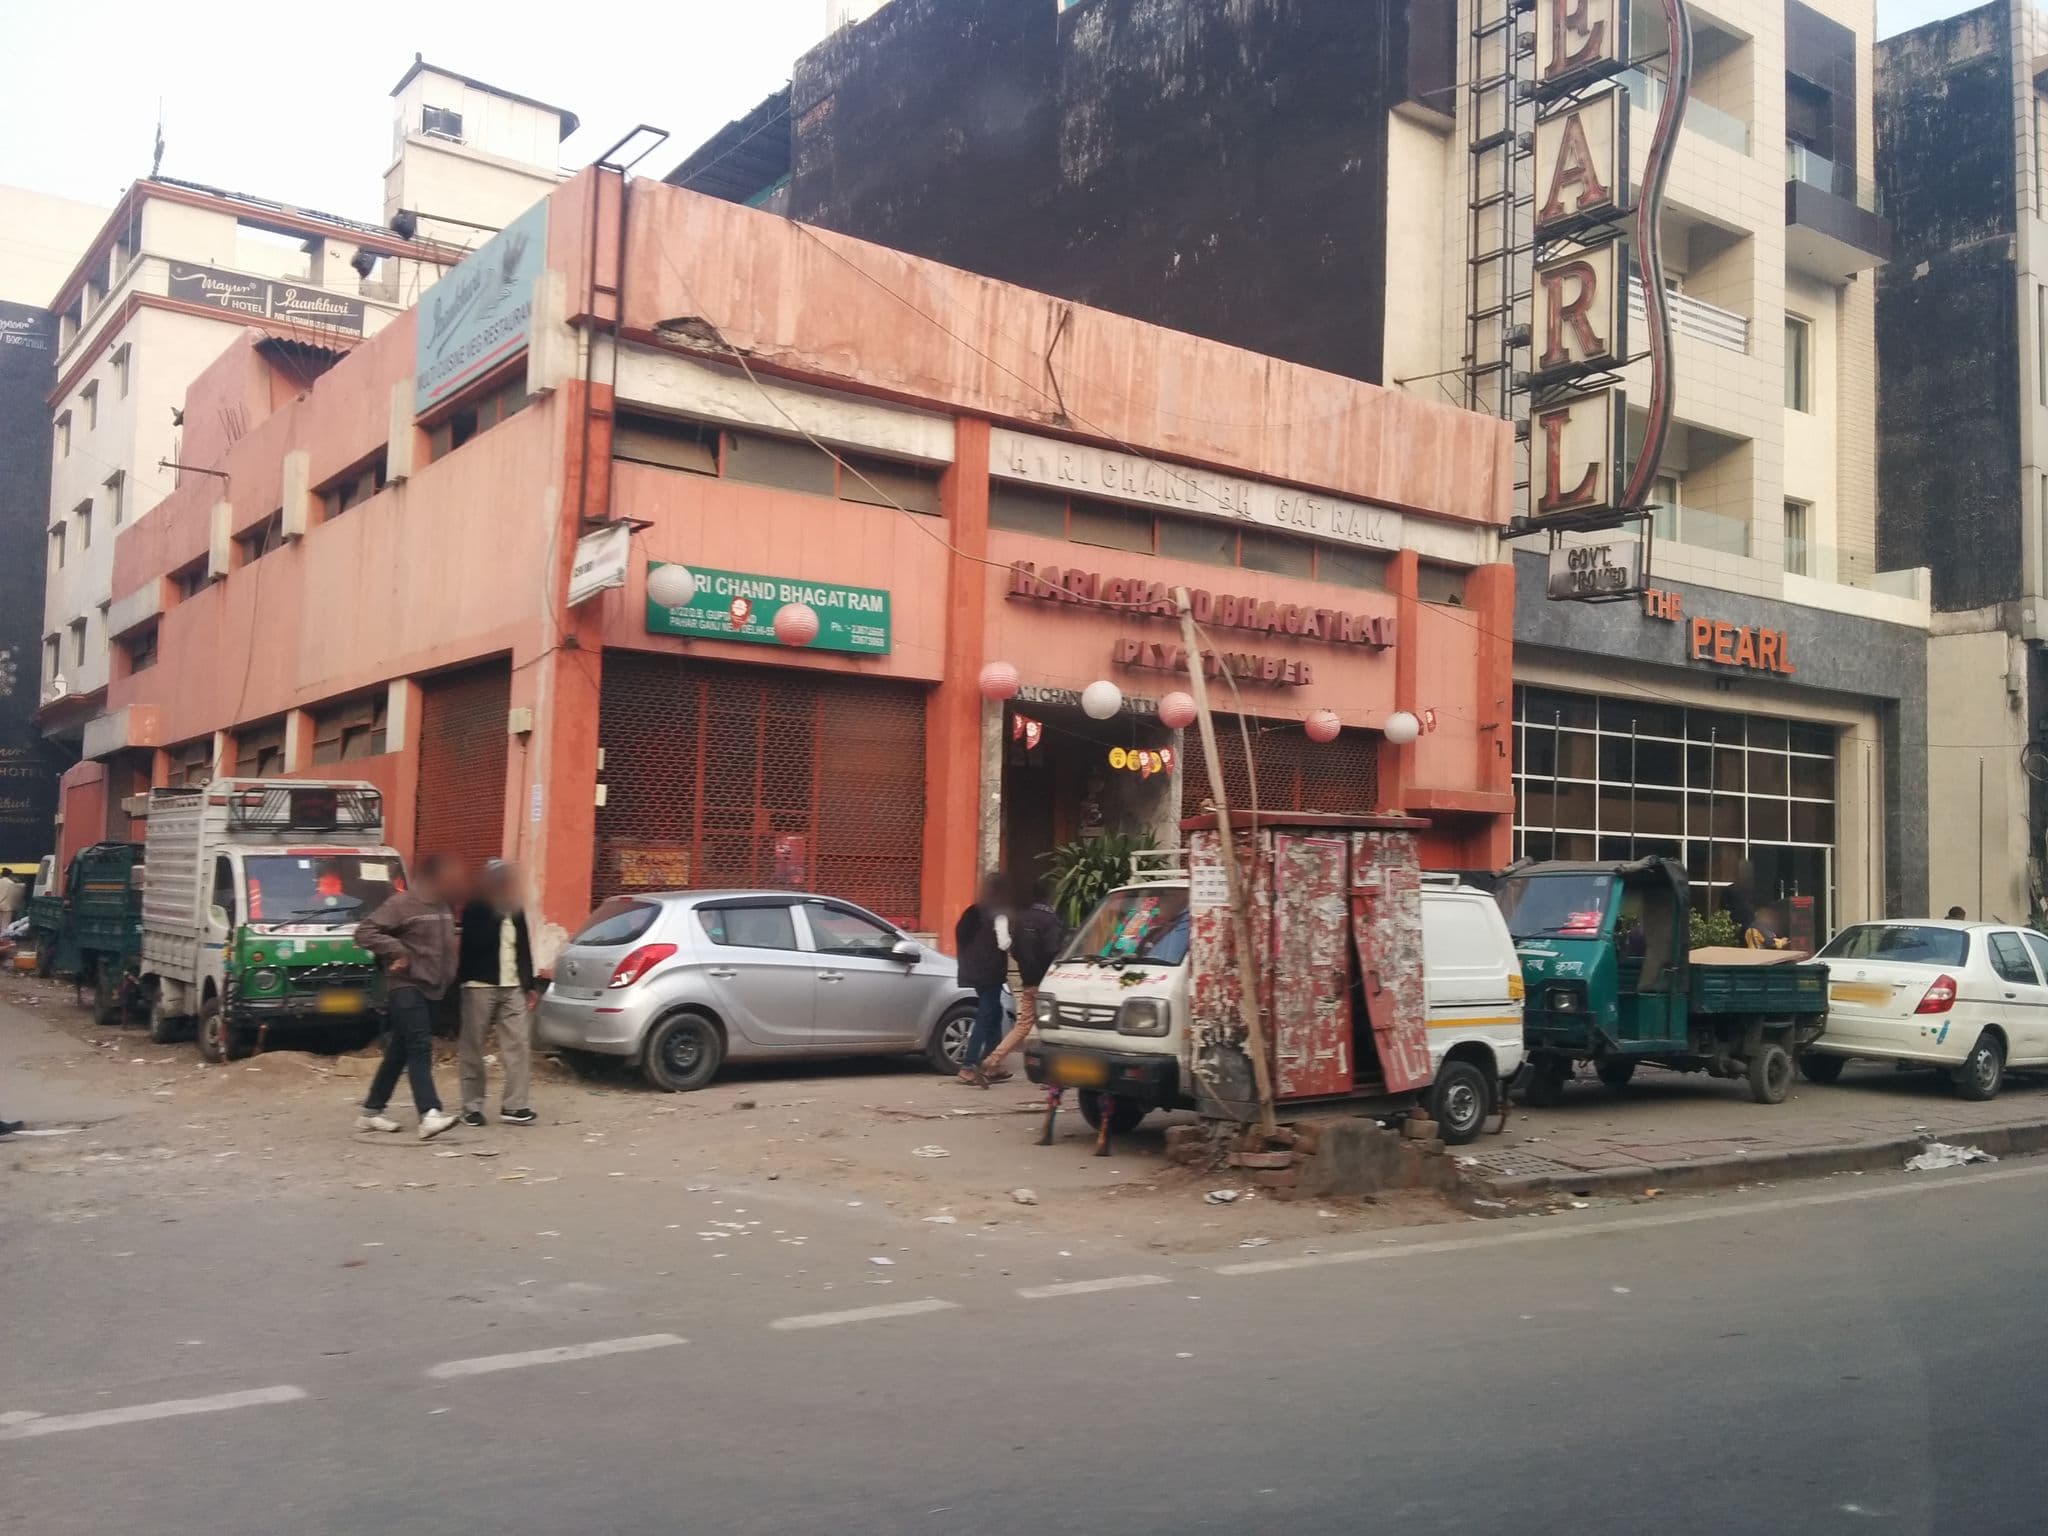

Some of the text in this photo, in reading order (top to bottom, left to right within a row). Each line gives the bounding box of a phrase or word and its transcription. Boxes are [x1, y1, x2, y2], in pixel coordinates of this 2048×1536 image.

[231, 300, 265, 314] HOTEL
[1101, 459, 1200, 504] CHAND
[1331, 501, 1385, 543] RAM
[715, 576, 777, 600] CHAND
[1644, 587, 1682, 622] THE
[1688, 615, 1796, 674] PEARL
